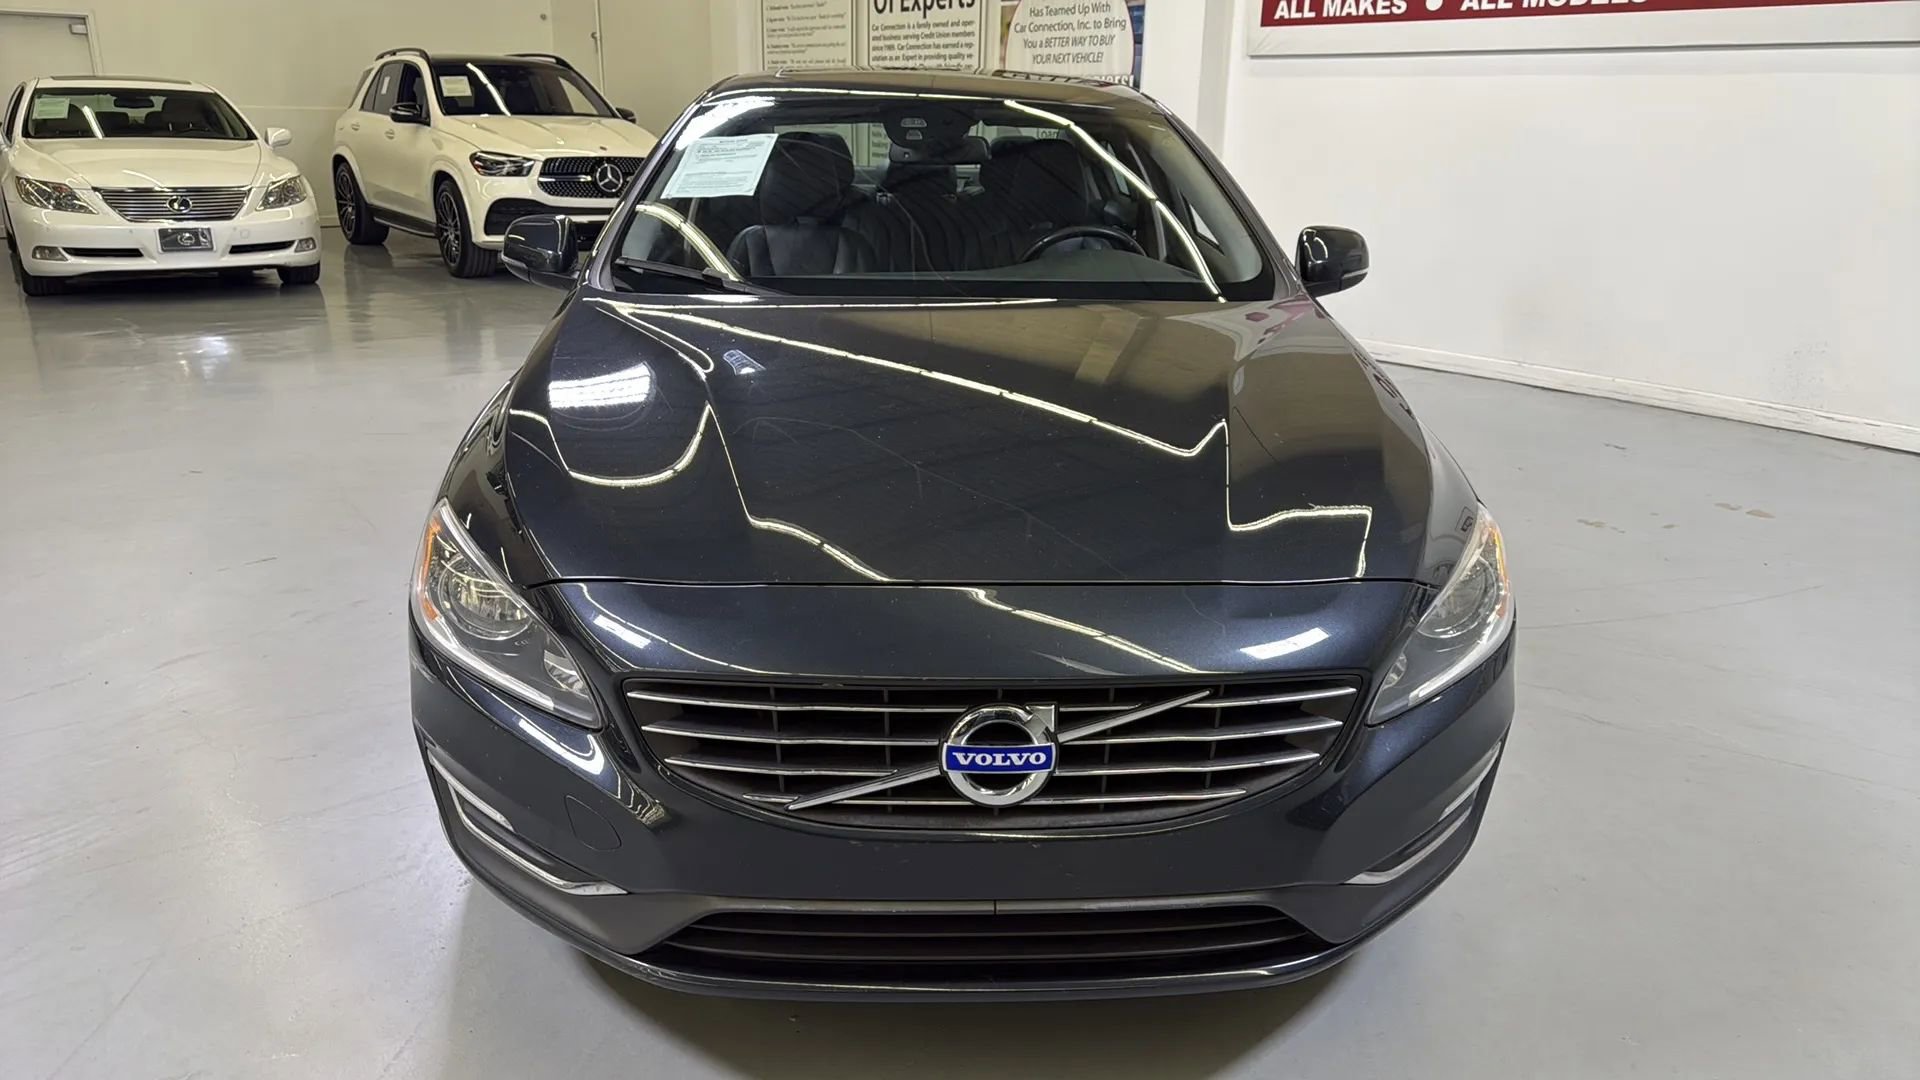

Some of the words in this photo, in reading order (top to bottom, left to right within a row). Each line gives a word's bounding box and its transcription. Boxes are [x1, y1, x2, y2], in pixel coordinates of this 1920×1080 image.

[1029, 7, 1044, 17] Has
[1045, 4, 1076, 16] Teamed
[1078, 4, 1090, 16] Up
[1091, 2, 1111, 13] With
[1274, 0, 1316, 19] ALL
[1322, 0, 1407, 17] MAKES
[932, 20, 949, 28] owned
[950, 19, 961, 27] and
[1014, 23, 1027, 33] Car
[1028, 20, 1075, 32] Connection,
[1077, 20, 1091, 30] Inc.
[1093, 20, 1102, 29] to
[1104, 17, 1127, 31] Bring
[1023, 38, 1037, 49] You
[1038, 40, 1043, 48] a
[1044, 36, 1070, 48] BETTER
[1071, 35, 1087, 47] WAY
[1088, 35, 1099, 46] TO
[1099, 34, 1116, 46] BUY
[1032, 54, 1052, 64] YOUR
[1052, 52, 1071, 64] NEXT
[1071, 51, 1104, 63] VEHICLE!
[952, 752, 1047, 766] VOLVO
